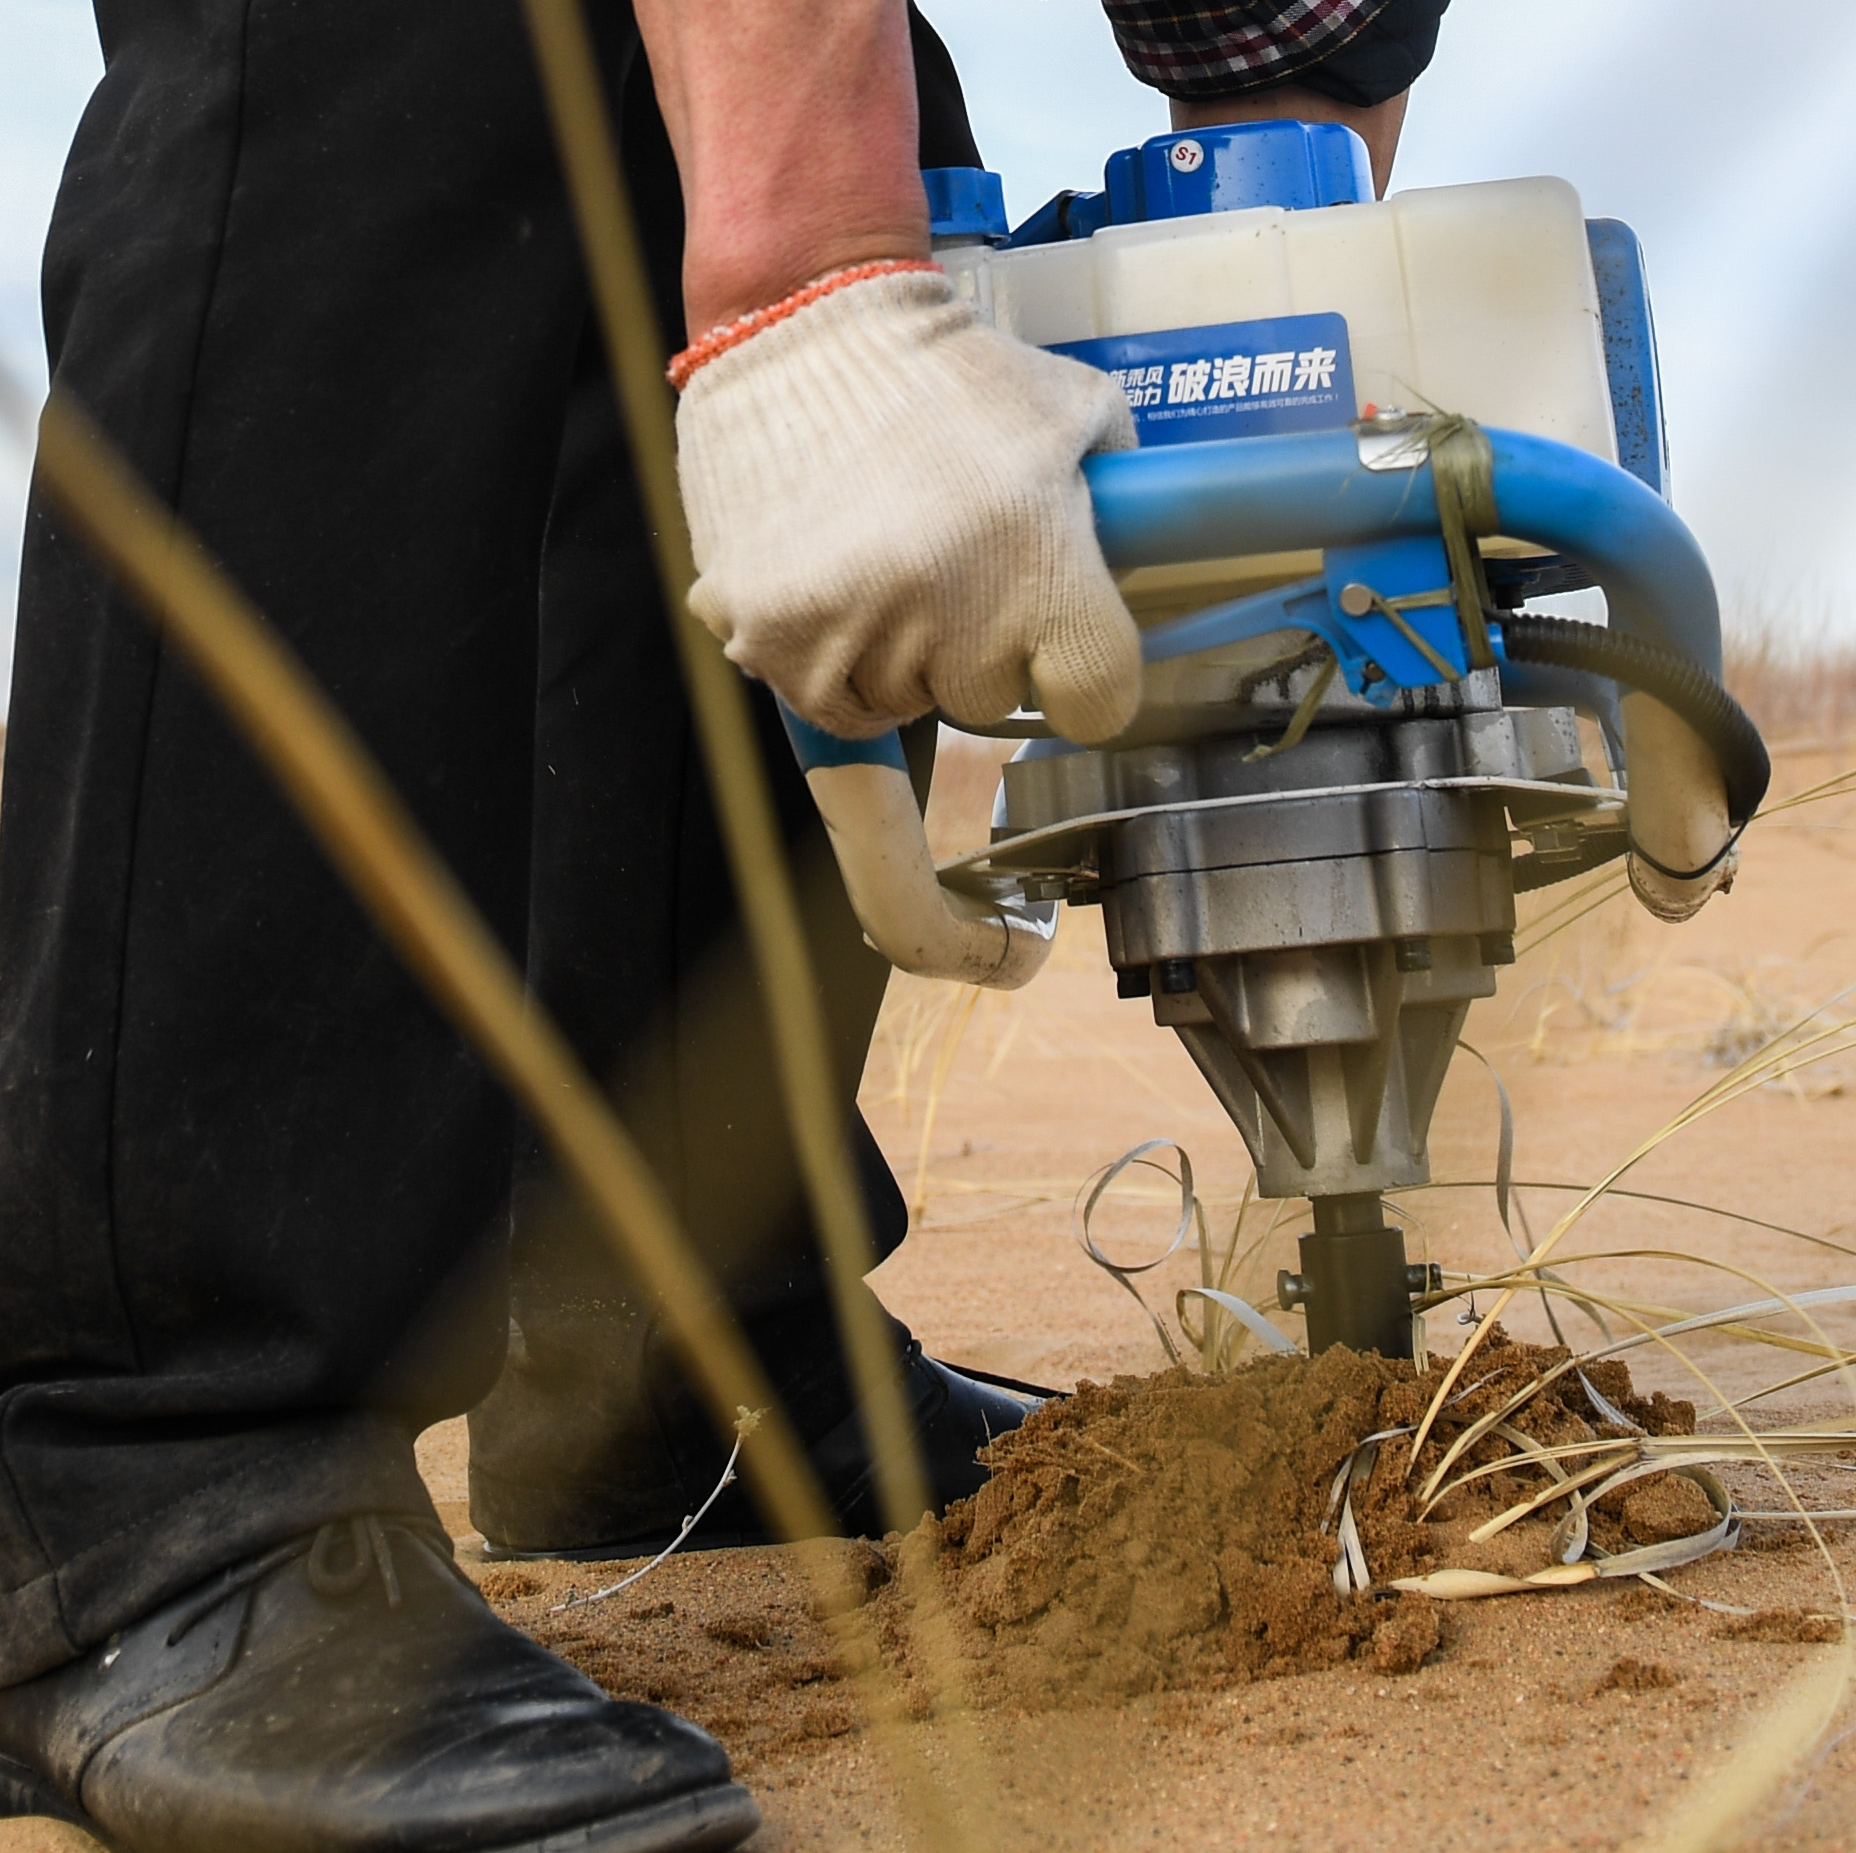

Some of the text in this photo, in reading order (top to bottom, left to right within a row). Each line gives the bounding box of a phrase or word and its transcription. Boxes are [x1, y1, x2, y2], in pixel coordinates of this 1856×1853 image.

[1175, 146, 1197, 165] S1
[1167, 346, 1337, 405] 破浪而来
[1126, 386, 1162, 407] 动力
